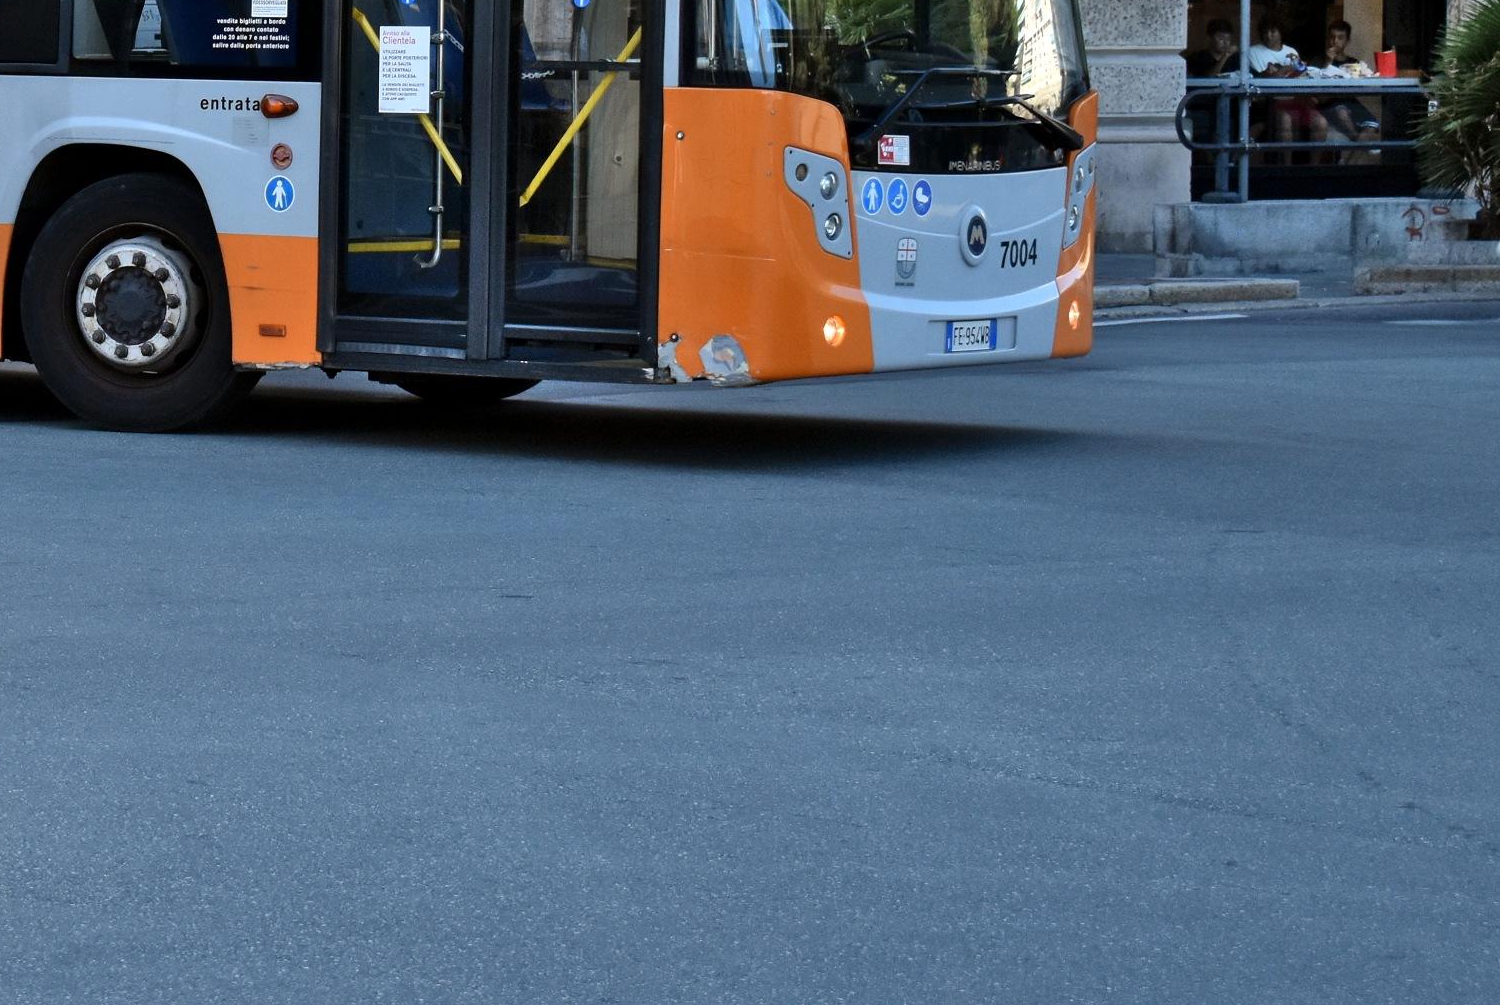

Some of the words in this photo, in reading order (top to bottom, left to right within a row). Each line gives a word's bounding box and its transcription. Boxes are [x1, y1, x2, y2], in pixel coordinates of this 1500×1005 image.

[382, 36, 416, 45] Clientela
[200, 96, 260, 111] entrata
[969, 224, 985, 245] M
[1000, 239, 1037, 269] 7004
